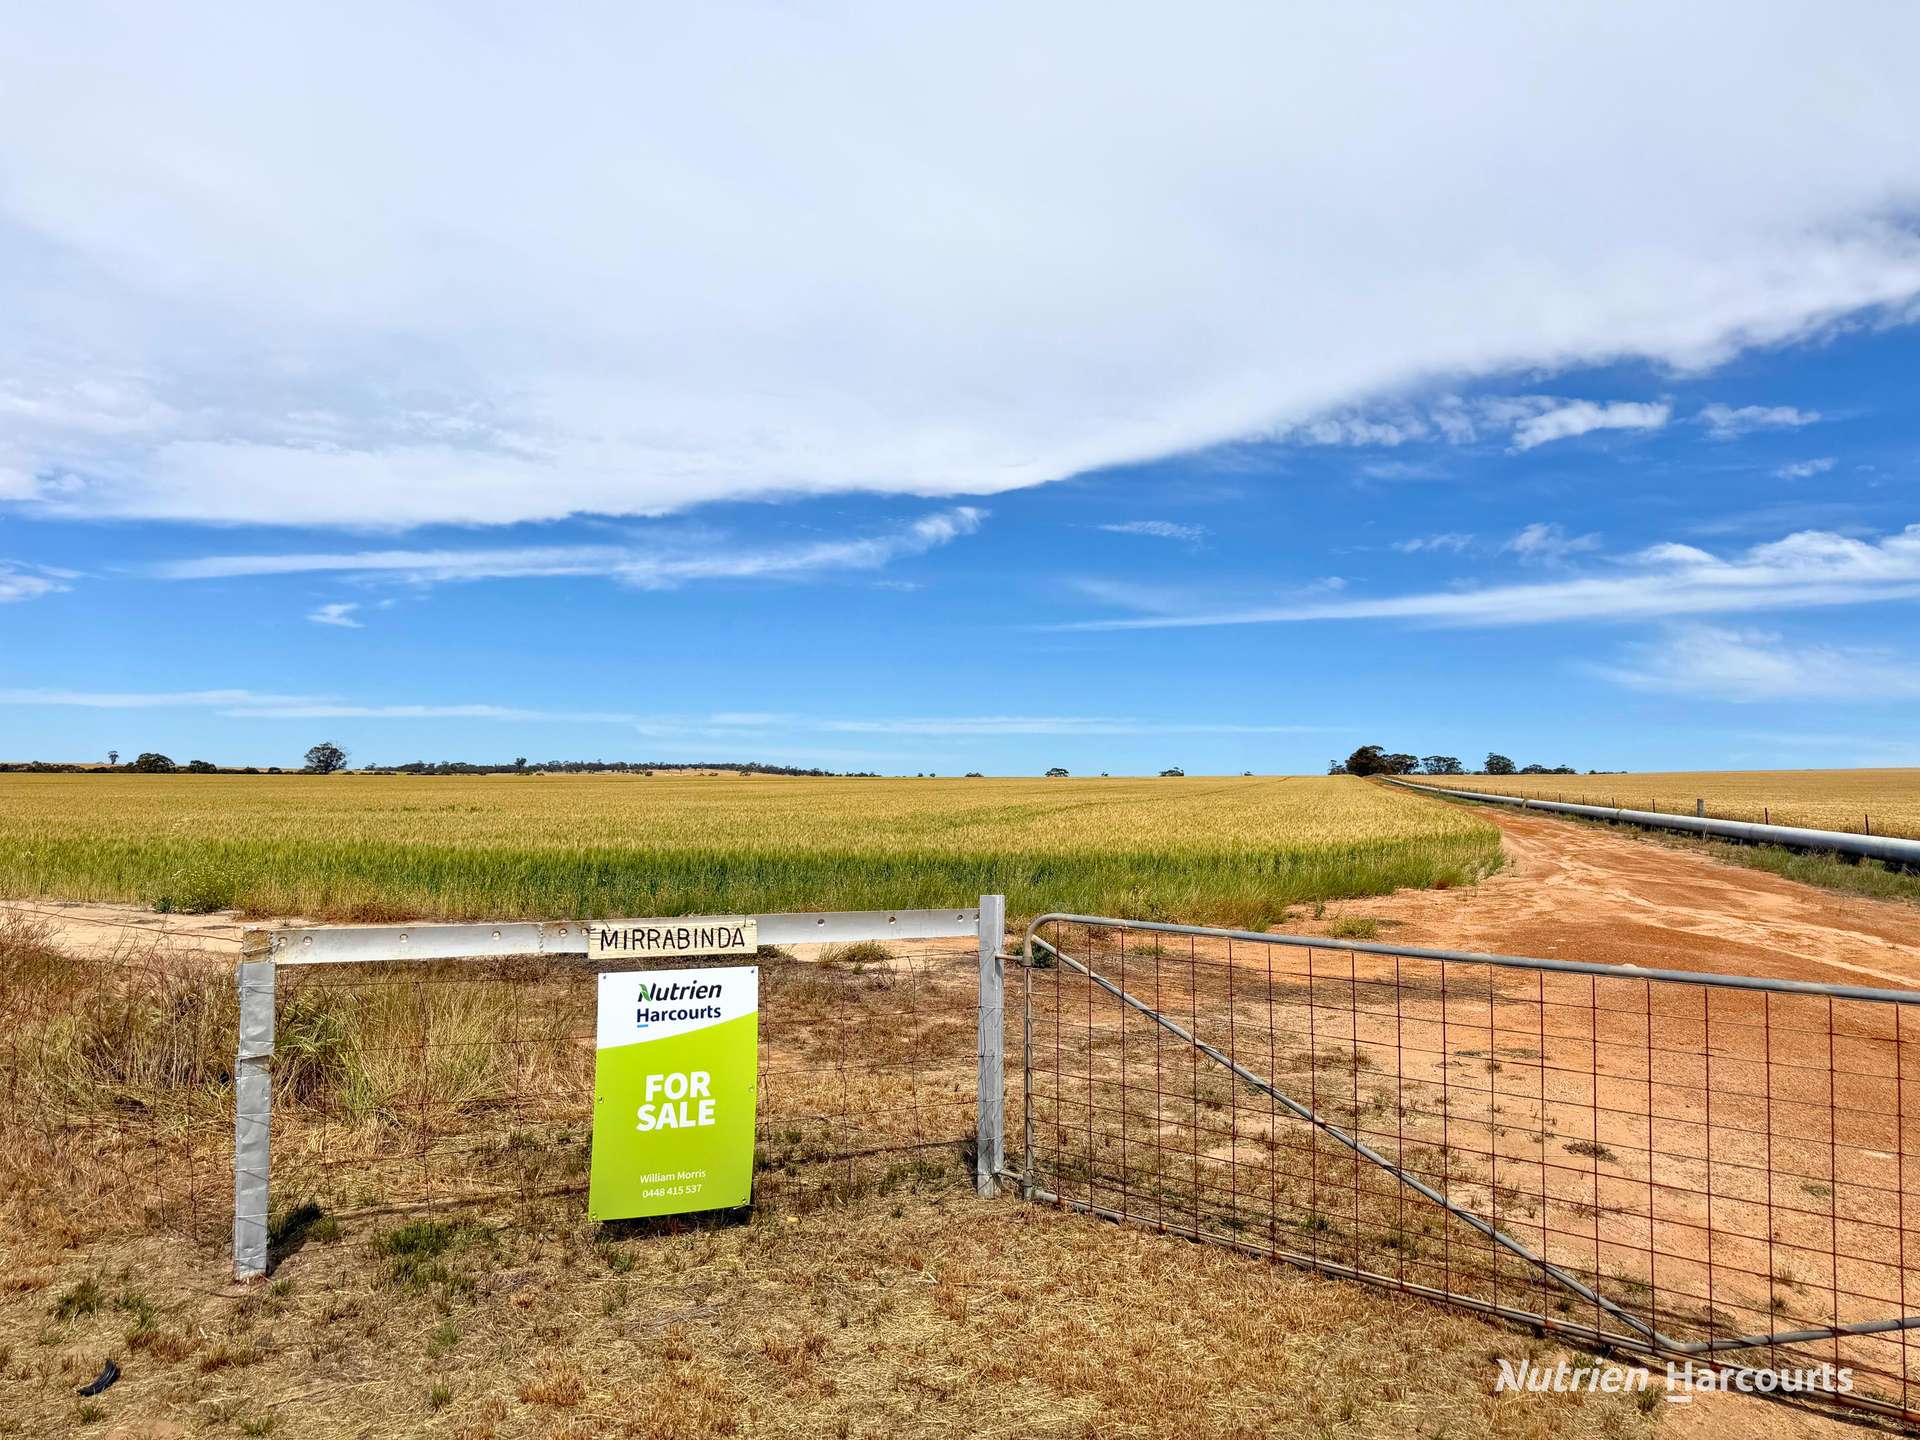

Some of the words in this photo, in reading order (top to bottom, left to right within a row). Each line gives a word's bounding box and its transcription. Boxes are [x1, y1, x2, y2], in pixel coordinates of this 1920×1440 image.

[600, 927, 745, 951] MIRRABINDA
[637, 980, 722, 1003] Nutrien
[636, 1005, 721, 1023] Harcourts
[645, 1071, 711, 1102] FOR
[635, 1099, 716, 1132] SALE
[640, 1173, 675, 1184] William
[677, 1168, 706, 1180] Morris
[642, 1188, 665, 1198] 0448
[667, 1186, 684, 1196] 415
[686, 1184, 702, 1195] 537
